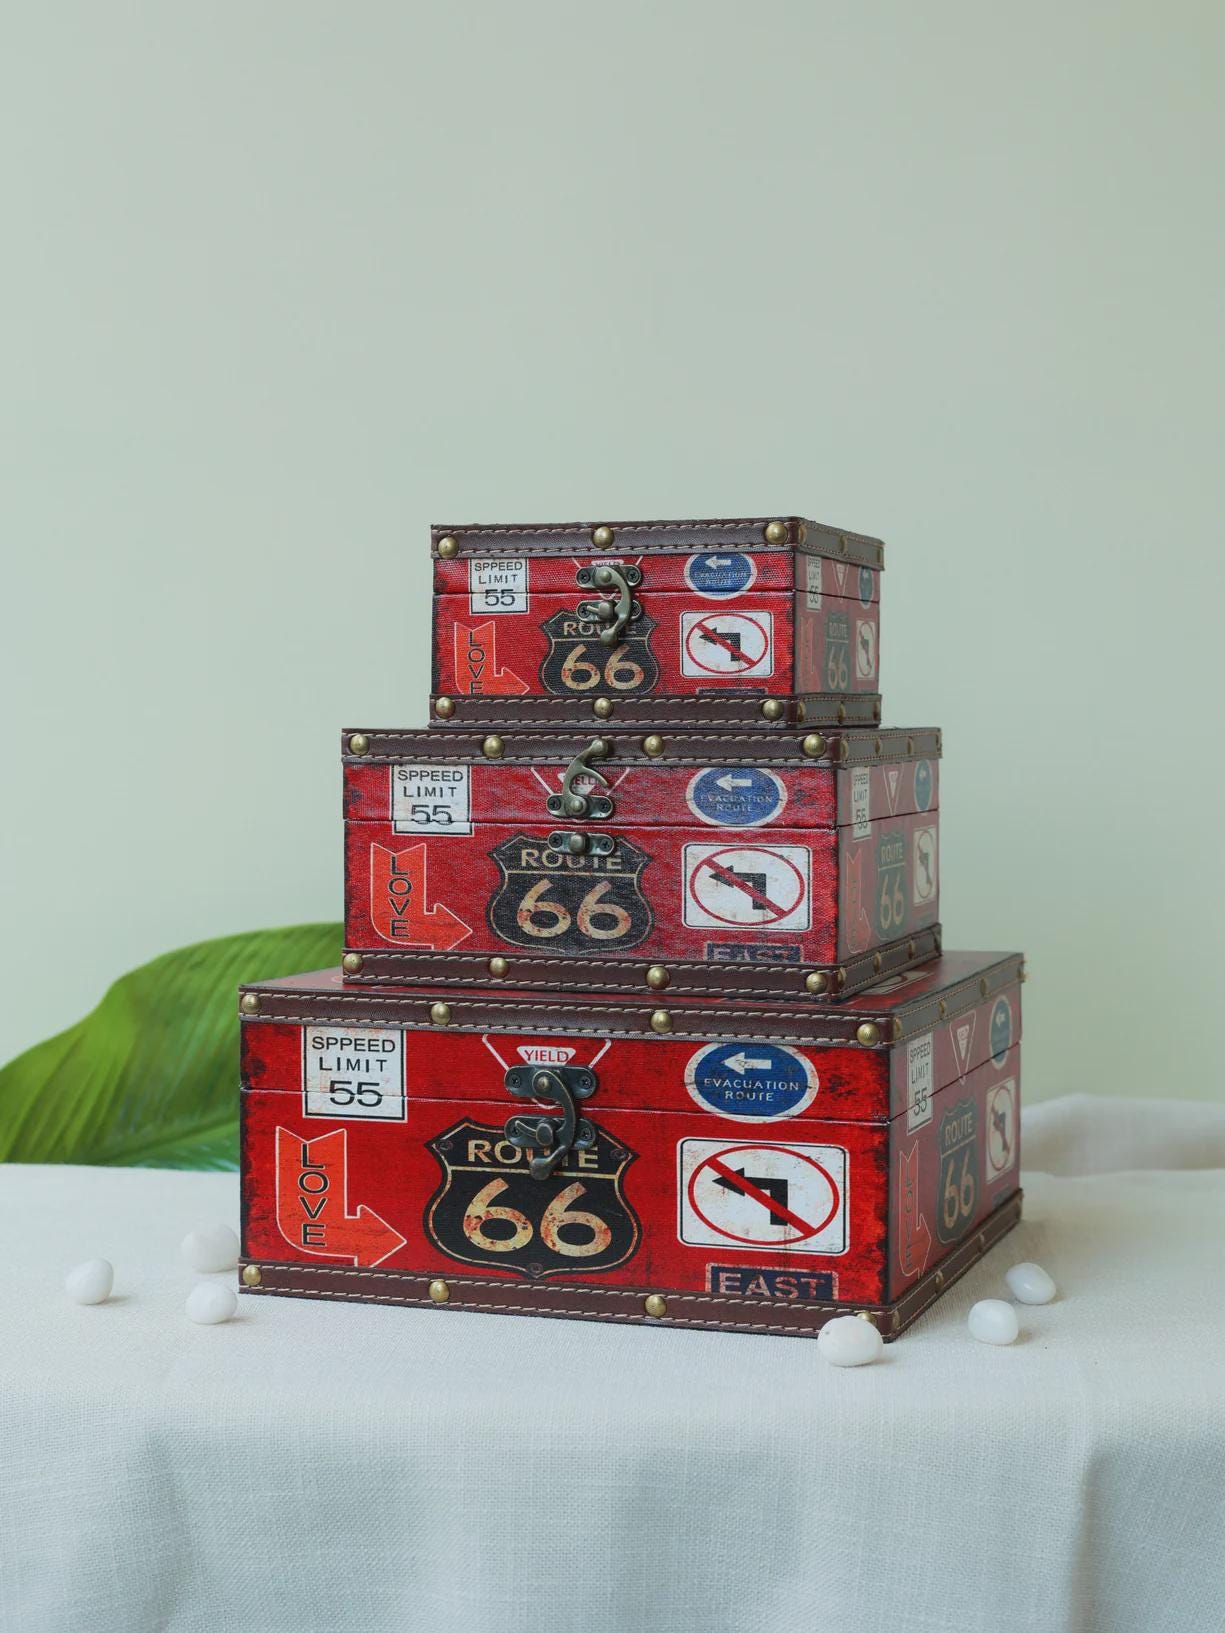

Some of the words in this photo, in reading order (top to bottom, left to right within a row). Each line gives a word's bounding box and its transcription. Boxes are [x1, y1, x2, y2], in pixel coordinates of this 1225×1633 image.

[474, 561, 523, 572] SPPEED
[478, 574, 518, 584] LIMIT
[484, 589, 516, 606] 55
[563, 621, 637, 635] ROE
[467, 631, 486, 695] LOVE
[561, 644, 645, 690] 66
[828, 646, 848, 690] 66
[397, 770, 464, 782] SPPEED
[403, 786, 457, 798] LIMIT
[700, 792, 773, 803] EVACUATION
[410, 804, 453, 826] 55
[716, 803, 752, 812] ROUTE
[388, 856, 413, 938] LOVE
[880, 872, 905, 930] 66
[517, 878, 632, 940] 66
[311, 1036, 396, 1053] SPPEED
[524, 1049, 569, 1063] YIELD
[318, 1056, 388, 1073] LIMIT
[911, 1062, 929, 1085] LIMIT
[328, 1080, 383, 1107] 55
[704, 1078, 799, 1091] EVACUATION
[725, 1091, 774, 1101] ROUTE
[913, 1087, 928, 1116] 55
[945, 1112, 973, 1146] ROUTE
[467, 1139, 598, 1169] ROE
[297, 1143, 330, 1247] LOVE
[943, 1150, 976, 1229] 66
[463, 1177, 612, 1257] 66
[719, 1272, 826, 1299] EAST
